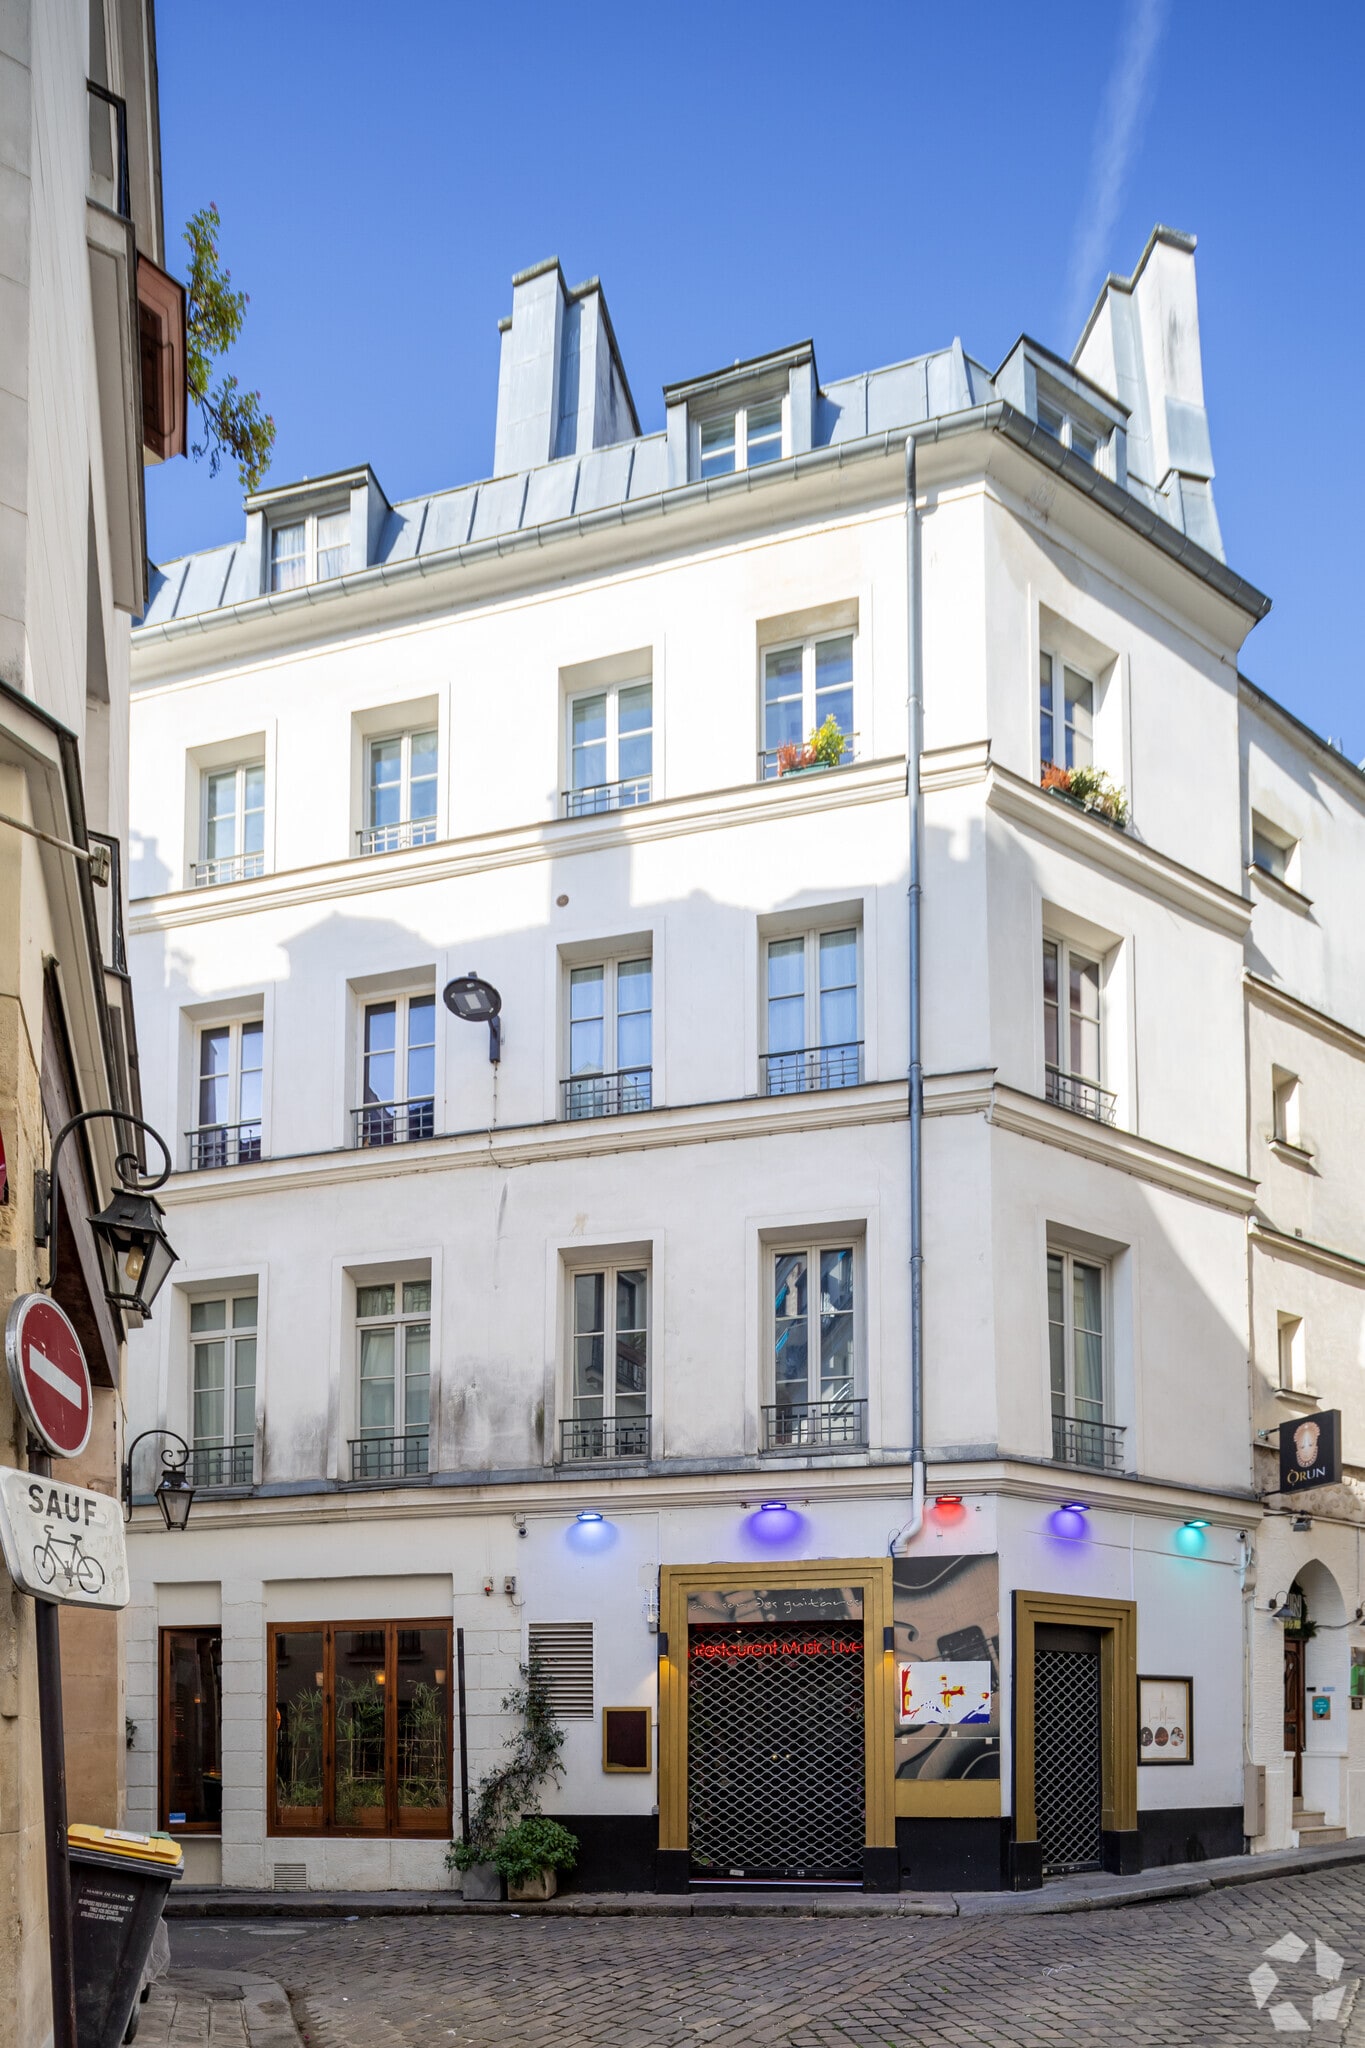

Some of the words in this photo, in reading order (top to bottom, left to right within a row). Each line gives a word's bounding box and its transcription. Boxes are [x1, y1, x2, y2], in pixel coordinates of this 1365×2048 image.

[28, 1483, 97, 1526] SAUF
[755, 1597, 778, 1609] des
[783, 1597, 862, 1614] guitares
[695, 1641, 778, 1657] Restaurant
